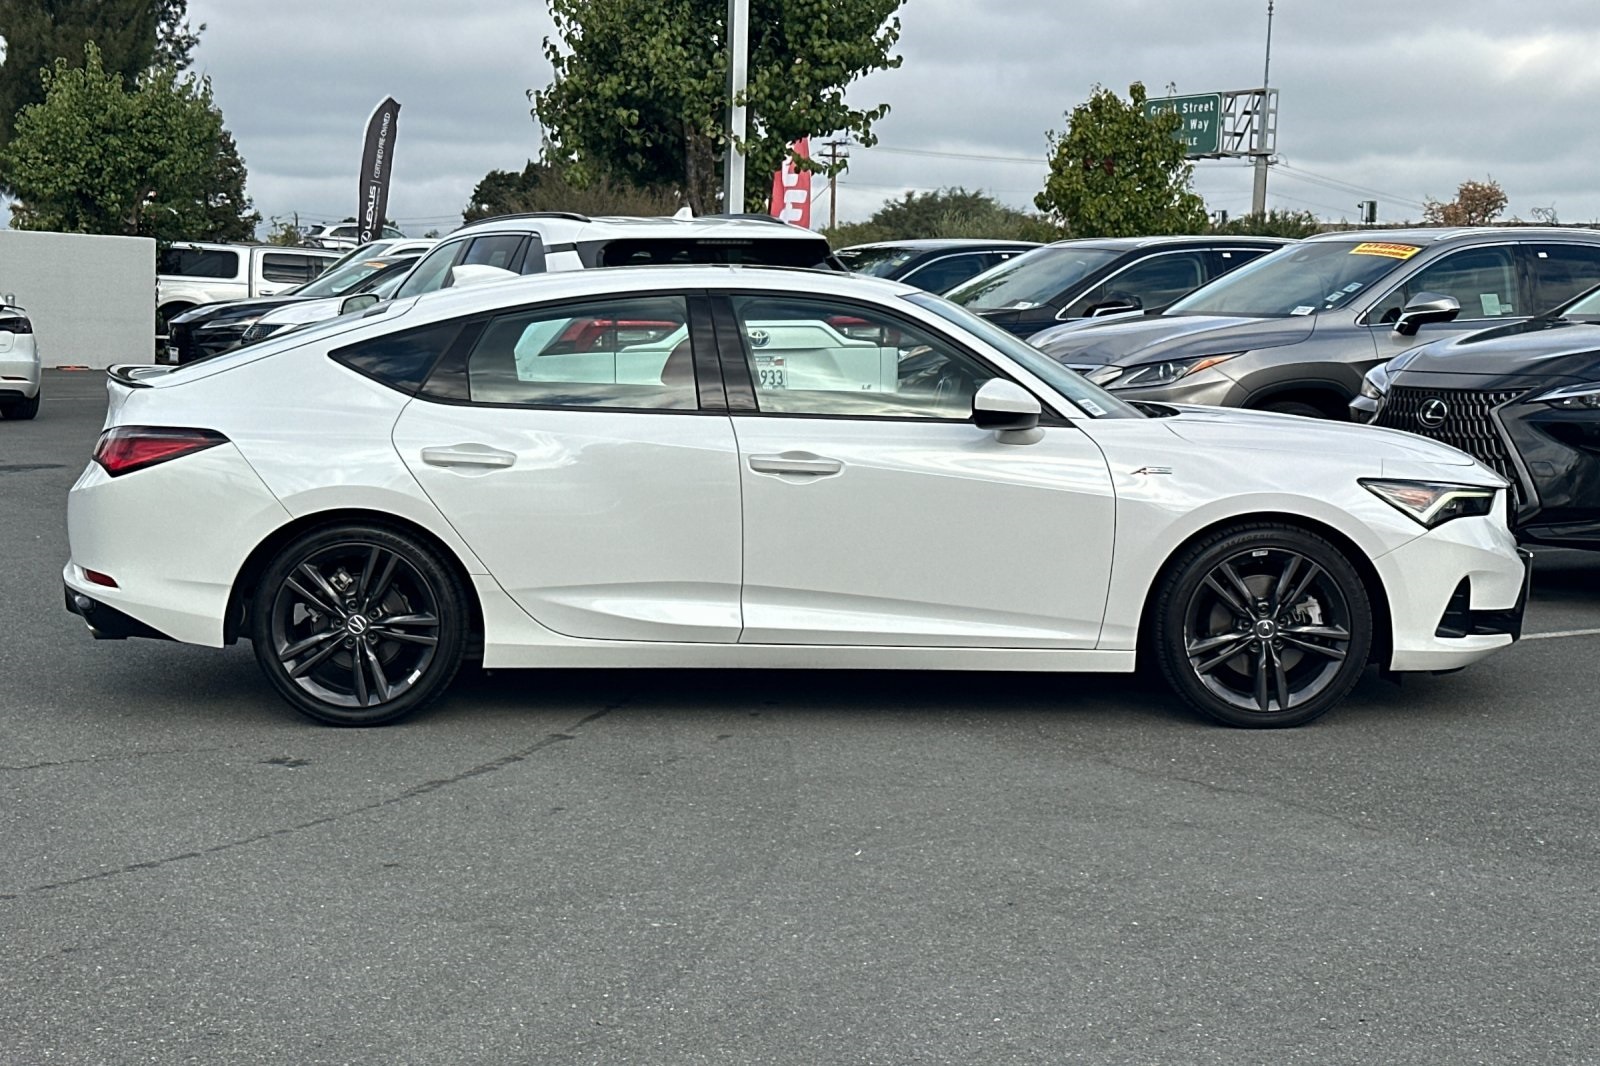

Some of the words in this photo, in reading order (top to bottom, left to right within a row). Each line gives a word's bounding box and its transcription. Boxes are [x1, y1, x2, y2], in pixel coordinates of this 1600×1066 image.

[1182, 100, 1214, 113] Street
[1190, 118, 1209, 133] Way
[364, 185, 377, 230] LEXUS
